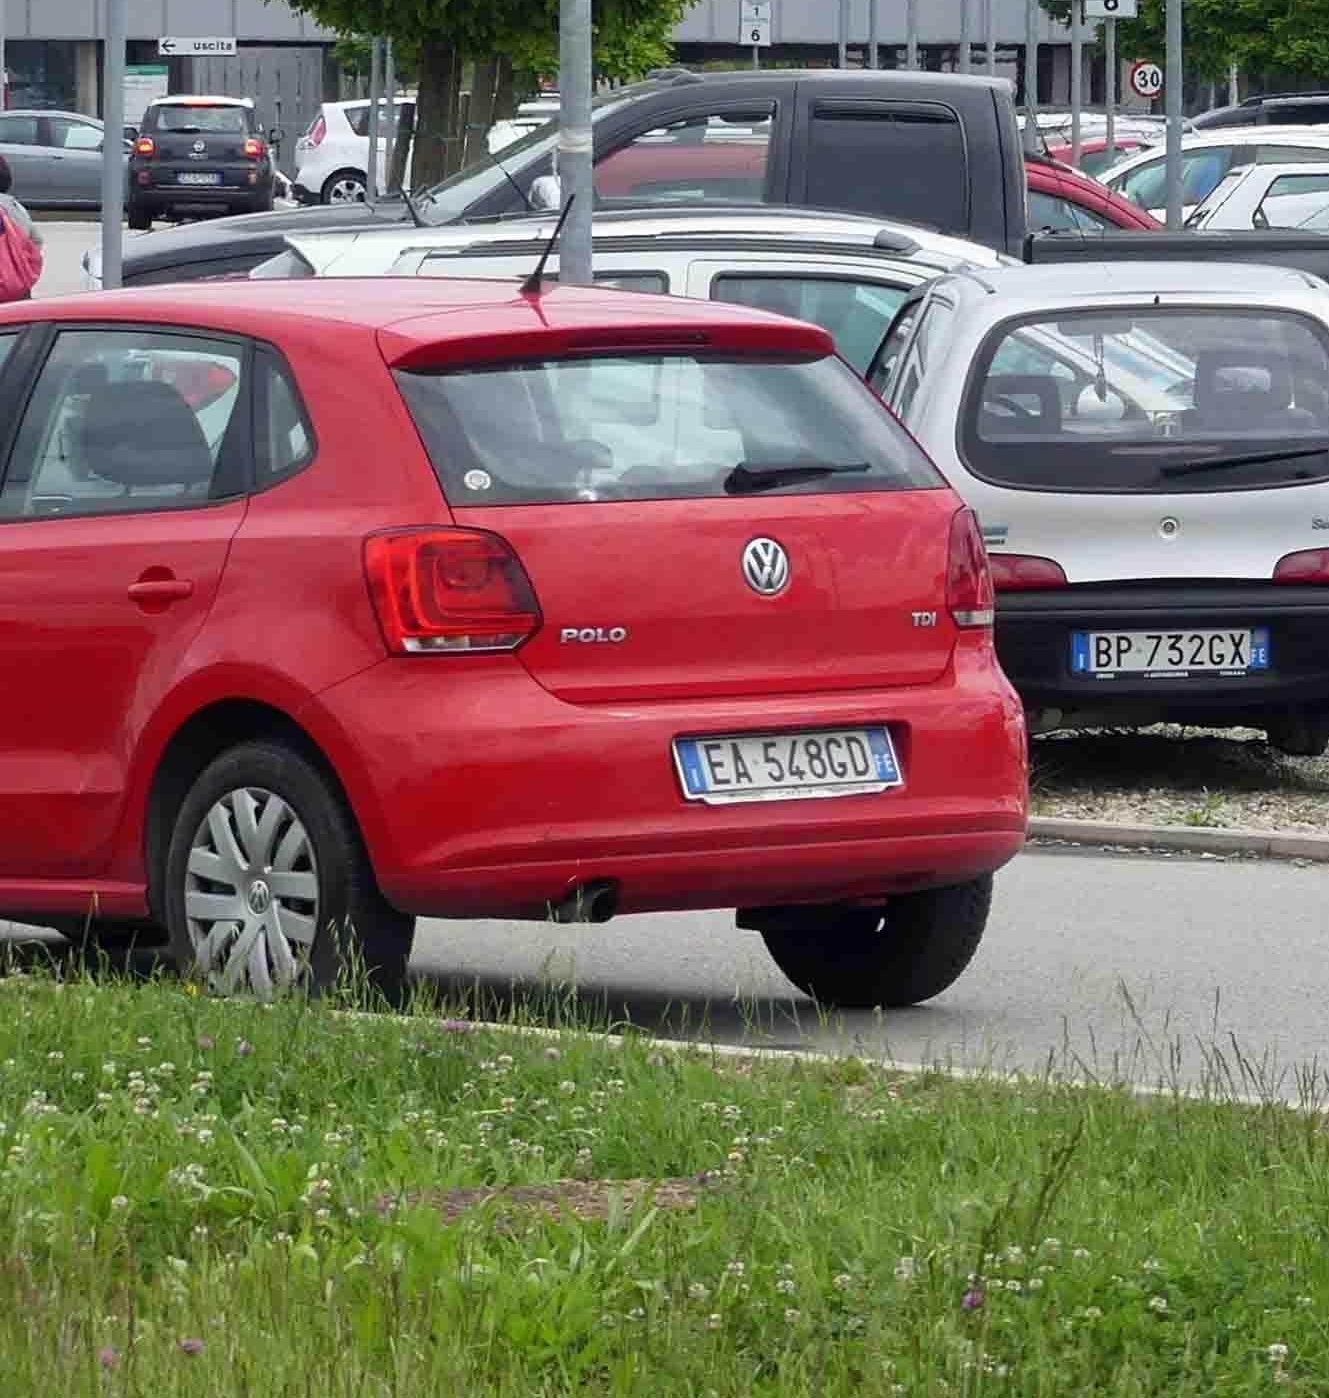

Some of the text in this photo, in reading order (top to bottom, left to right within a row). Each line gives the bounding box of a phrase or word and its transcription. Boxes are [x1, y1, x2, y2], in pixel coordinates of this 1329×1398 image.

[751, 29, 761, 42] 6
[193, 41, 233, 51] uscita
[1137, 70, 1160, 88] 30
[911, 611, 937, 627] TDI
[560, 626, 627, 644] POLO
[1095, 636, 1132, 668] BP
[1145, 632, 1246, 668] 732GX
[703, 741, 753, 786] EA
[762, 735, 870, 783] 548GD
